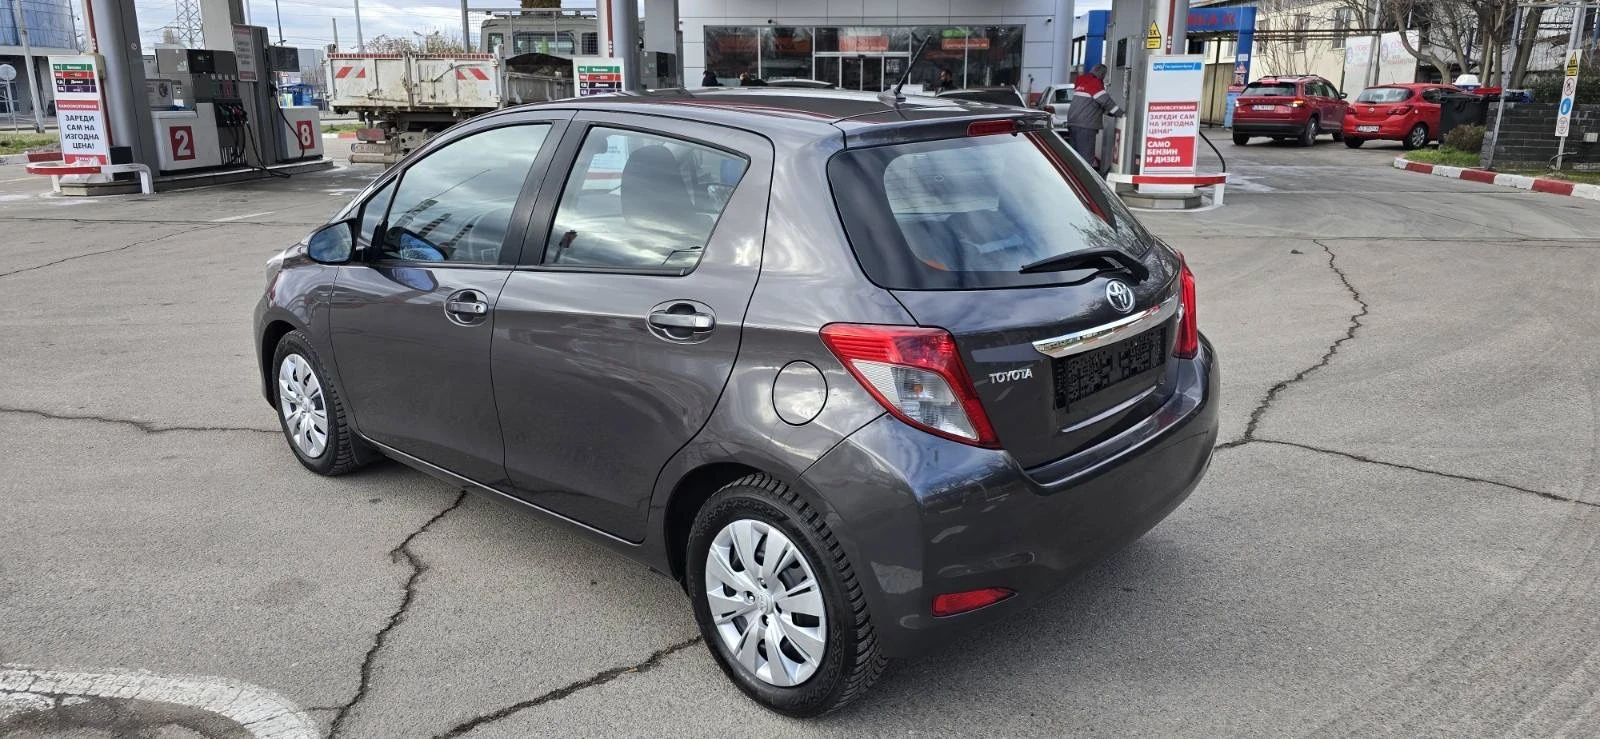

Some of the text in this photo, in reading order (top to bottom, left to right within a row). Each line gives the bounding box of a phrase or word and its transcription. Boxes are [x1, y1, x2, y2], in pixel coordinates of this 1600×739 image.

[1150, 113, 1178, 121] ЗАРЕДИ
[1161, 119, 1195, 127] ИЗГОДНА
[65, 133, 100, 141] ИЗГОДНА
[301, 125, 313, 146] 8
[72, 142, 95, 150] ЦЕНА!
[175, 130, 189, 157] 2
[1147, 140, 1171, 148] САМО
[1146, 148, 1178, 156] БЕНЗИН
[1154, 156, 1181, 164] ДИЗЕЛ
[989, 368, 1033, 384] TOYOTA
